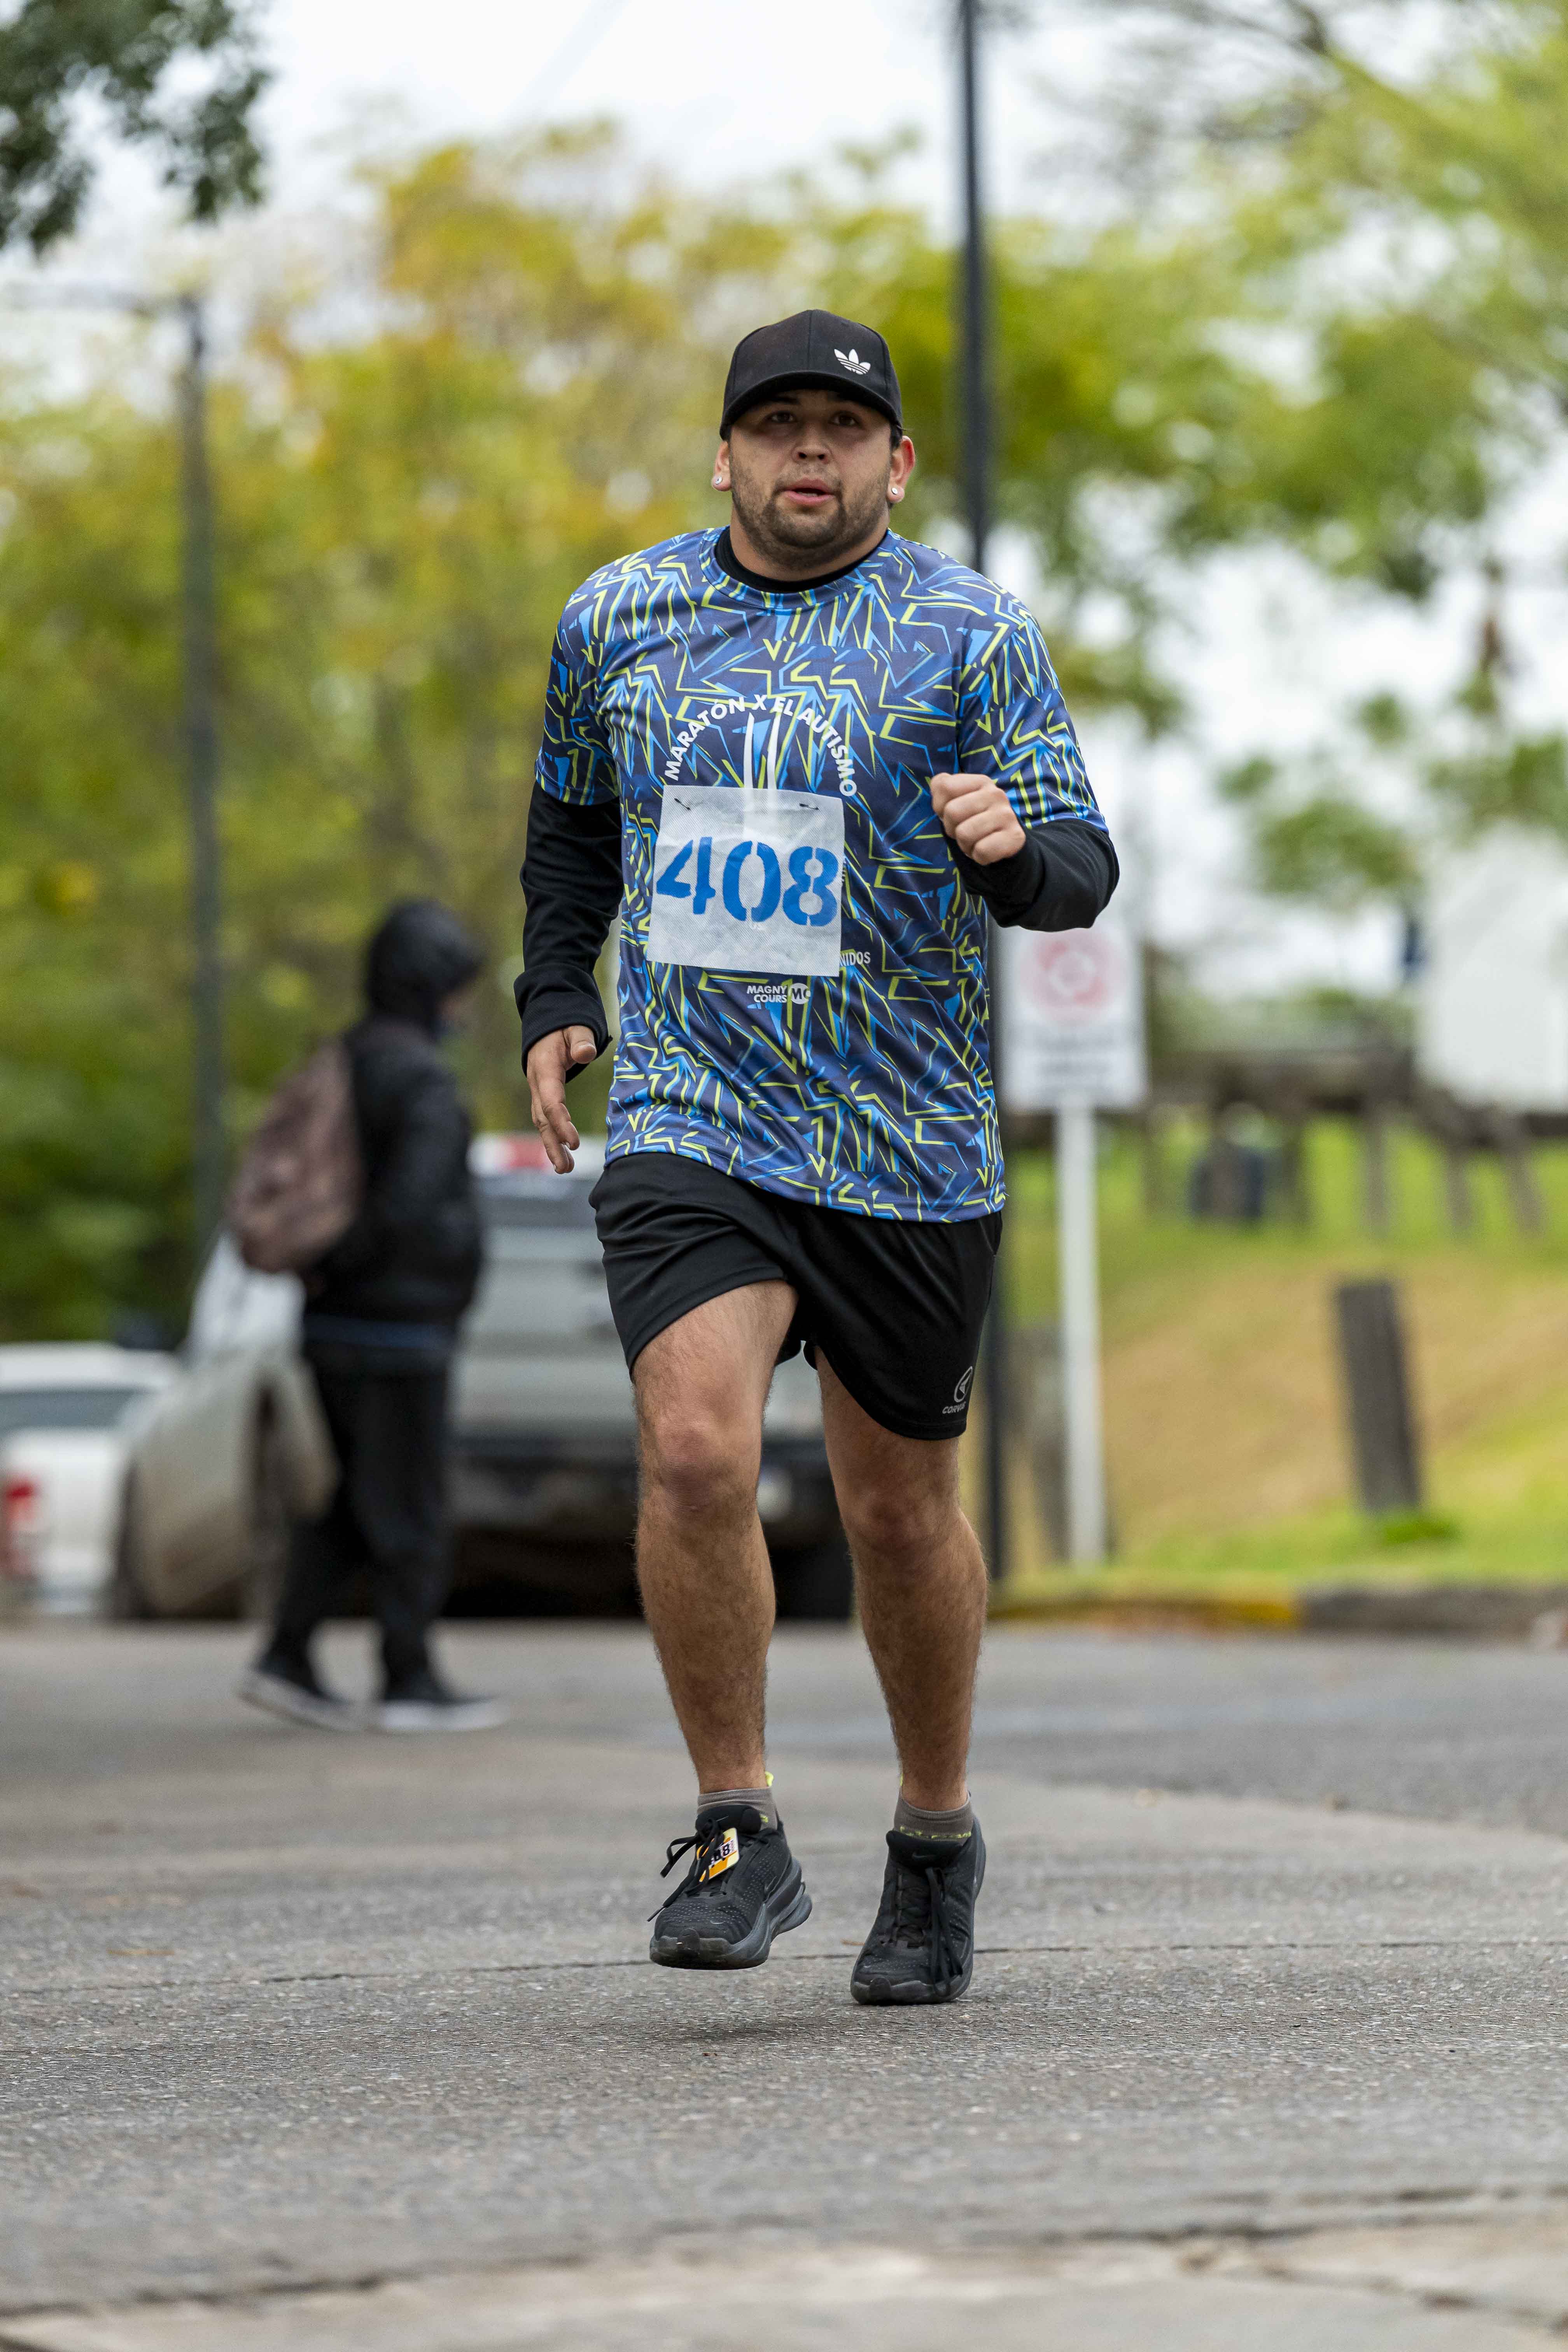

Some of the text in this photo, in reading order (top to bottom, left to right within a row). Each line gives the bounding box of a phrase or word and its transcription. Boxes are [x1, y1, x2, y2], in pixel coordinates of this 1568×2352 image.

[664, 694, 857, 797] MARATÓN X EL AUTISMO
[656, 836, 839, 927] 408
[840, 952, 871, 966] NIDOS
[747, 985, 788, 995] MAGNY
[753, 994, 788, 1003] COURS
